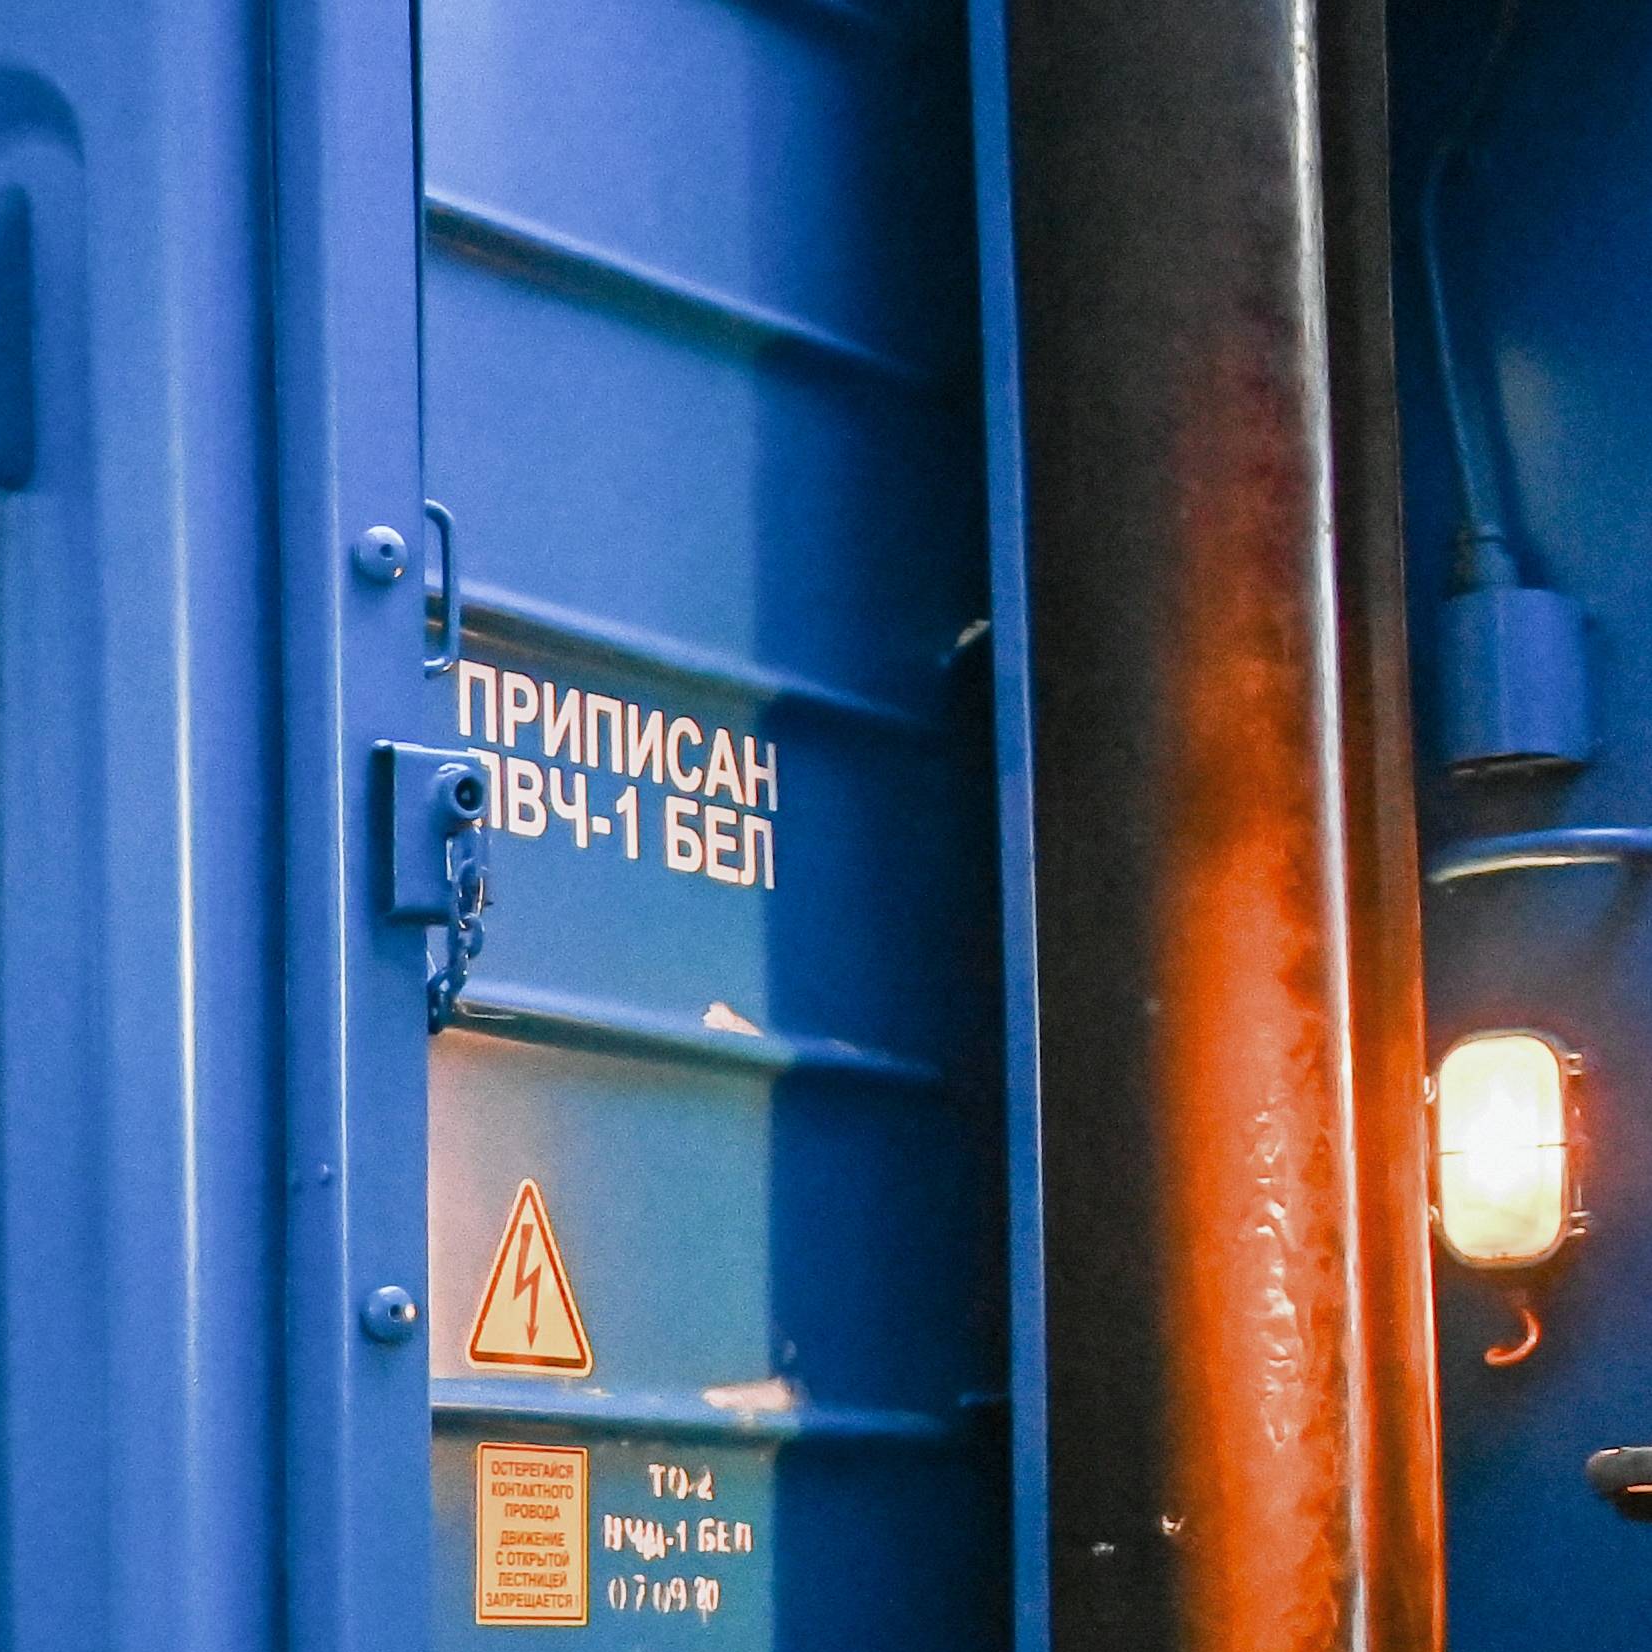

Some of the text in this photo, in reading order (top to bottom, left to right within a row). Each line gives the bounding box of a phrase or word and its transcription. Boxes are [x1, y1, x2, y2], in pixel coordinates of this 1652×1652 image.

[459, 659, 778, 812] ПРИПИСАН
[665, 795, 775, 889] БЕЛ
[491, 1461, 574, 1479] ОСТЕРЕГАЙСЯ
[491, 1482, 574, 1499] КОНТАКТНОГО
[504, 1503, 560, 1521] ПРОВОДА
[500, 1530, 566, 1547] ДВИЖЕНИЕ
[495, 1550, 570, 1567] С ОТКРЫТОЙ
[497, 1571, 567, 1589] ЛЕСТНИЦЕЙ
